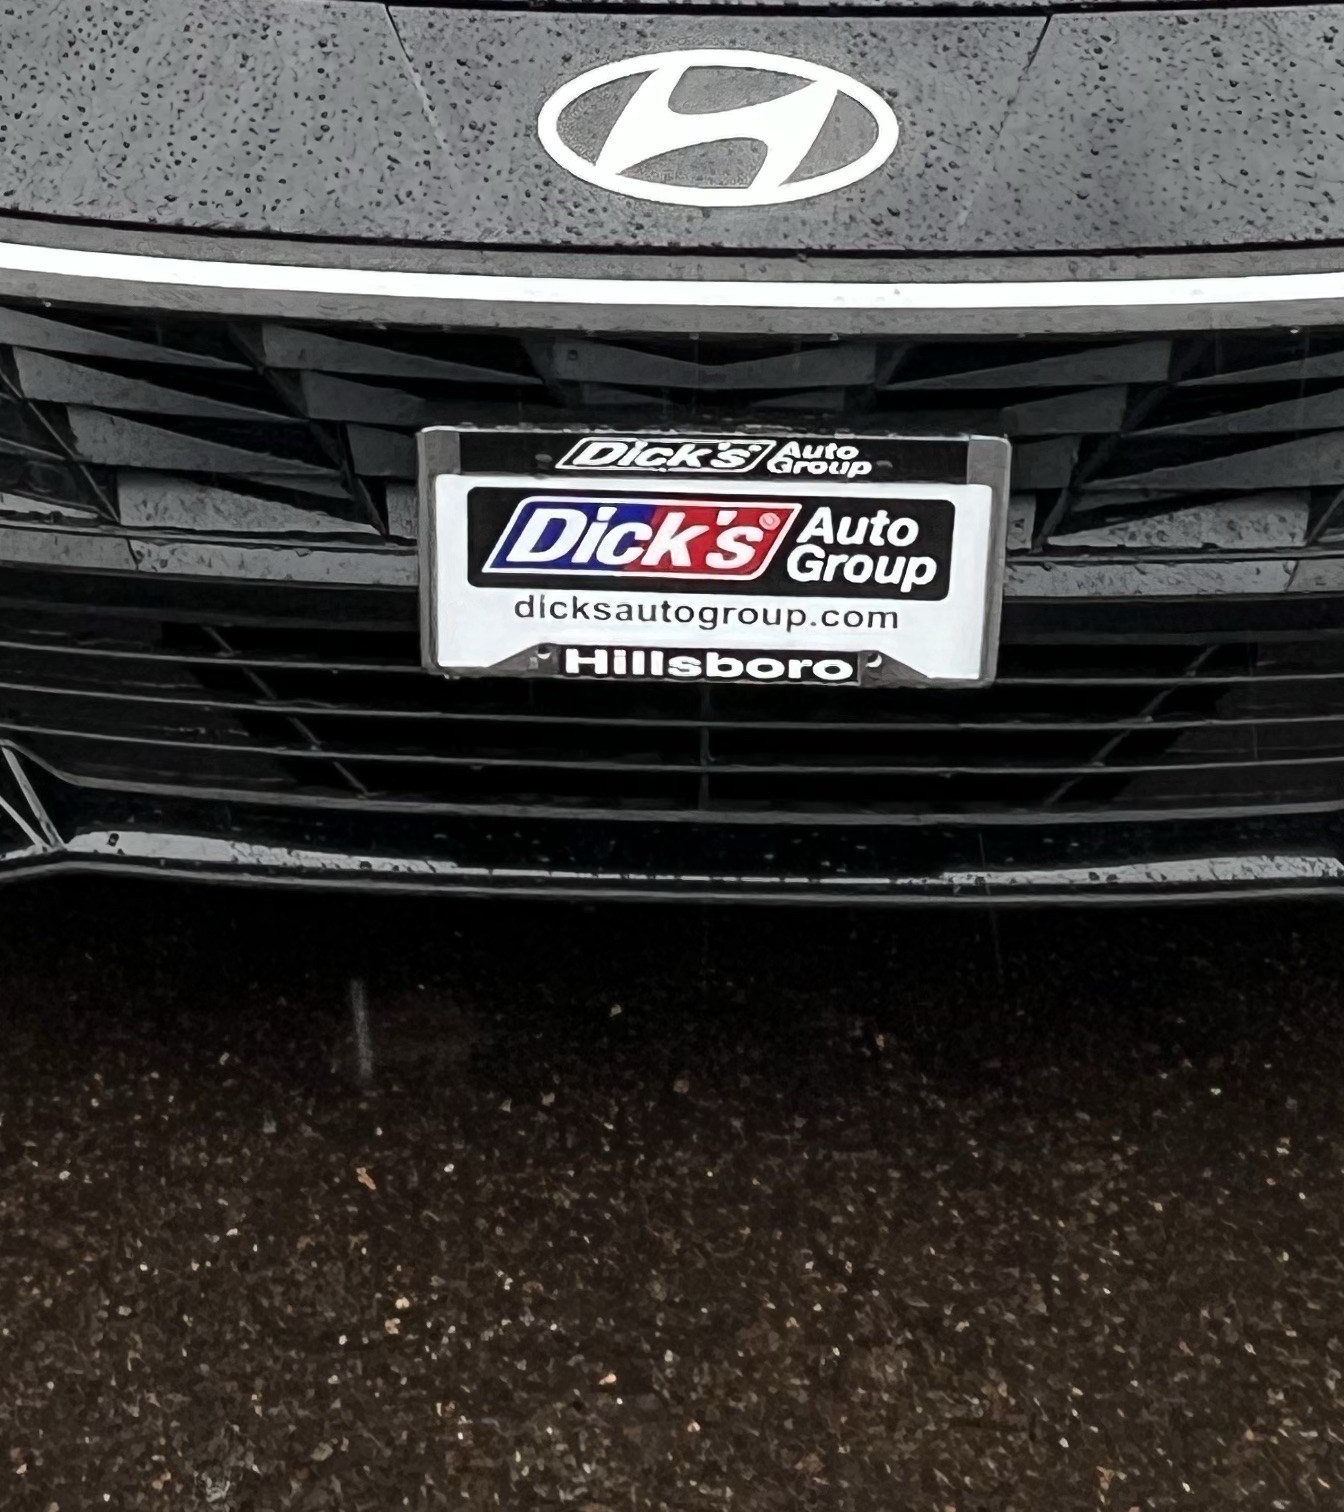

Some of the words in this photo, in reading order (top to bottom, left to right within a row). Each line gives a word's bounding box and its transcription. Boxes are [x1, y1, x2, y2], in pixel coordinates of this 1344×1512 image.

[572, 440, 752, 468] Dick's
[774, 441, 860, 460] Auto
[766, 457, 873, 478] Group
[506, 506, 765, 569] Dick's
[796, 506, 920, 547] Auto
[786, 543, 938, 593] Group
[514, 594, 899, 632] dicksautogroup.com
[564, 648, 854, 681] Hillsboro
